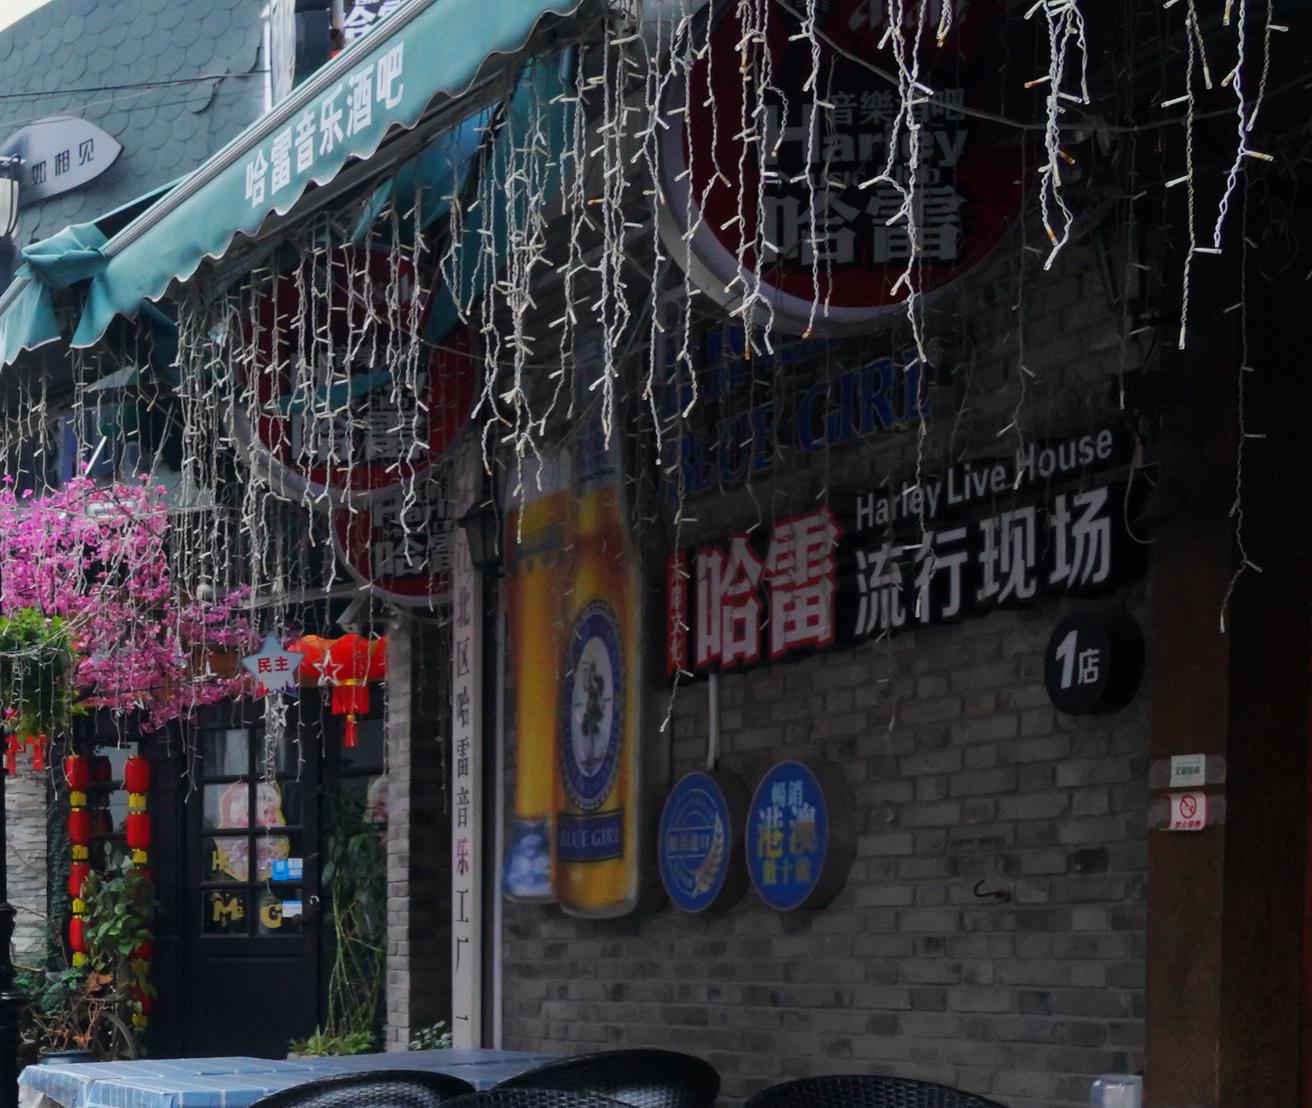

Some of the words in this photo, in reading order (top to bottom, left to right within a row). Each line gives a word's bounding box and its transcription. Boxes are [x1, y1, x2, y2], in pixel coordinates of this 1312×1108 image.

[245, 42, 404, 208] 哈雷音乐酒吧
[760, 185, 967, 266] 哈雷
[856, 478, 942, 532] Harley
[947, 458, 1005, 504] Live
[1016, 427, 1114, 478] House
[696, 510, 839, 667] 哈雷
[854, 487, 1113, 636] 流行现场
[257, 655, 289, 673] 民主
[1055, 629, 1100, 690] 1店
